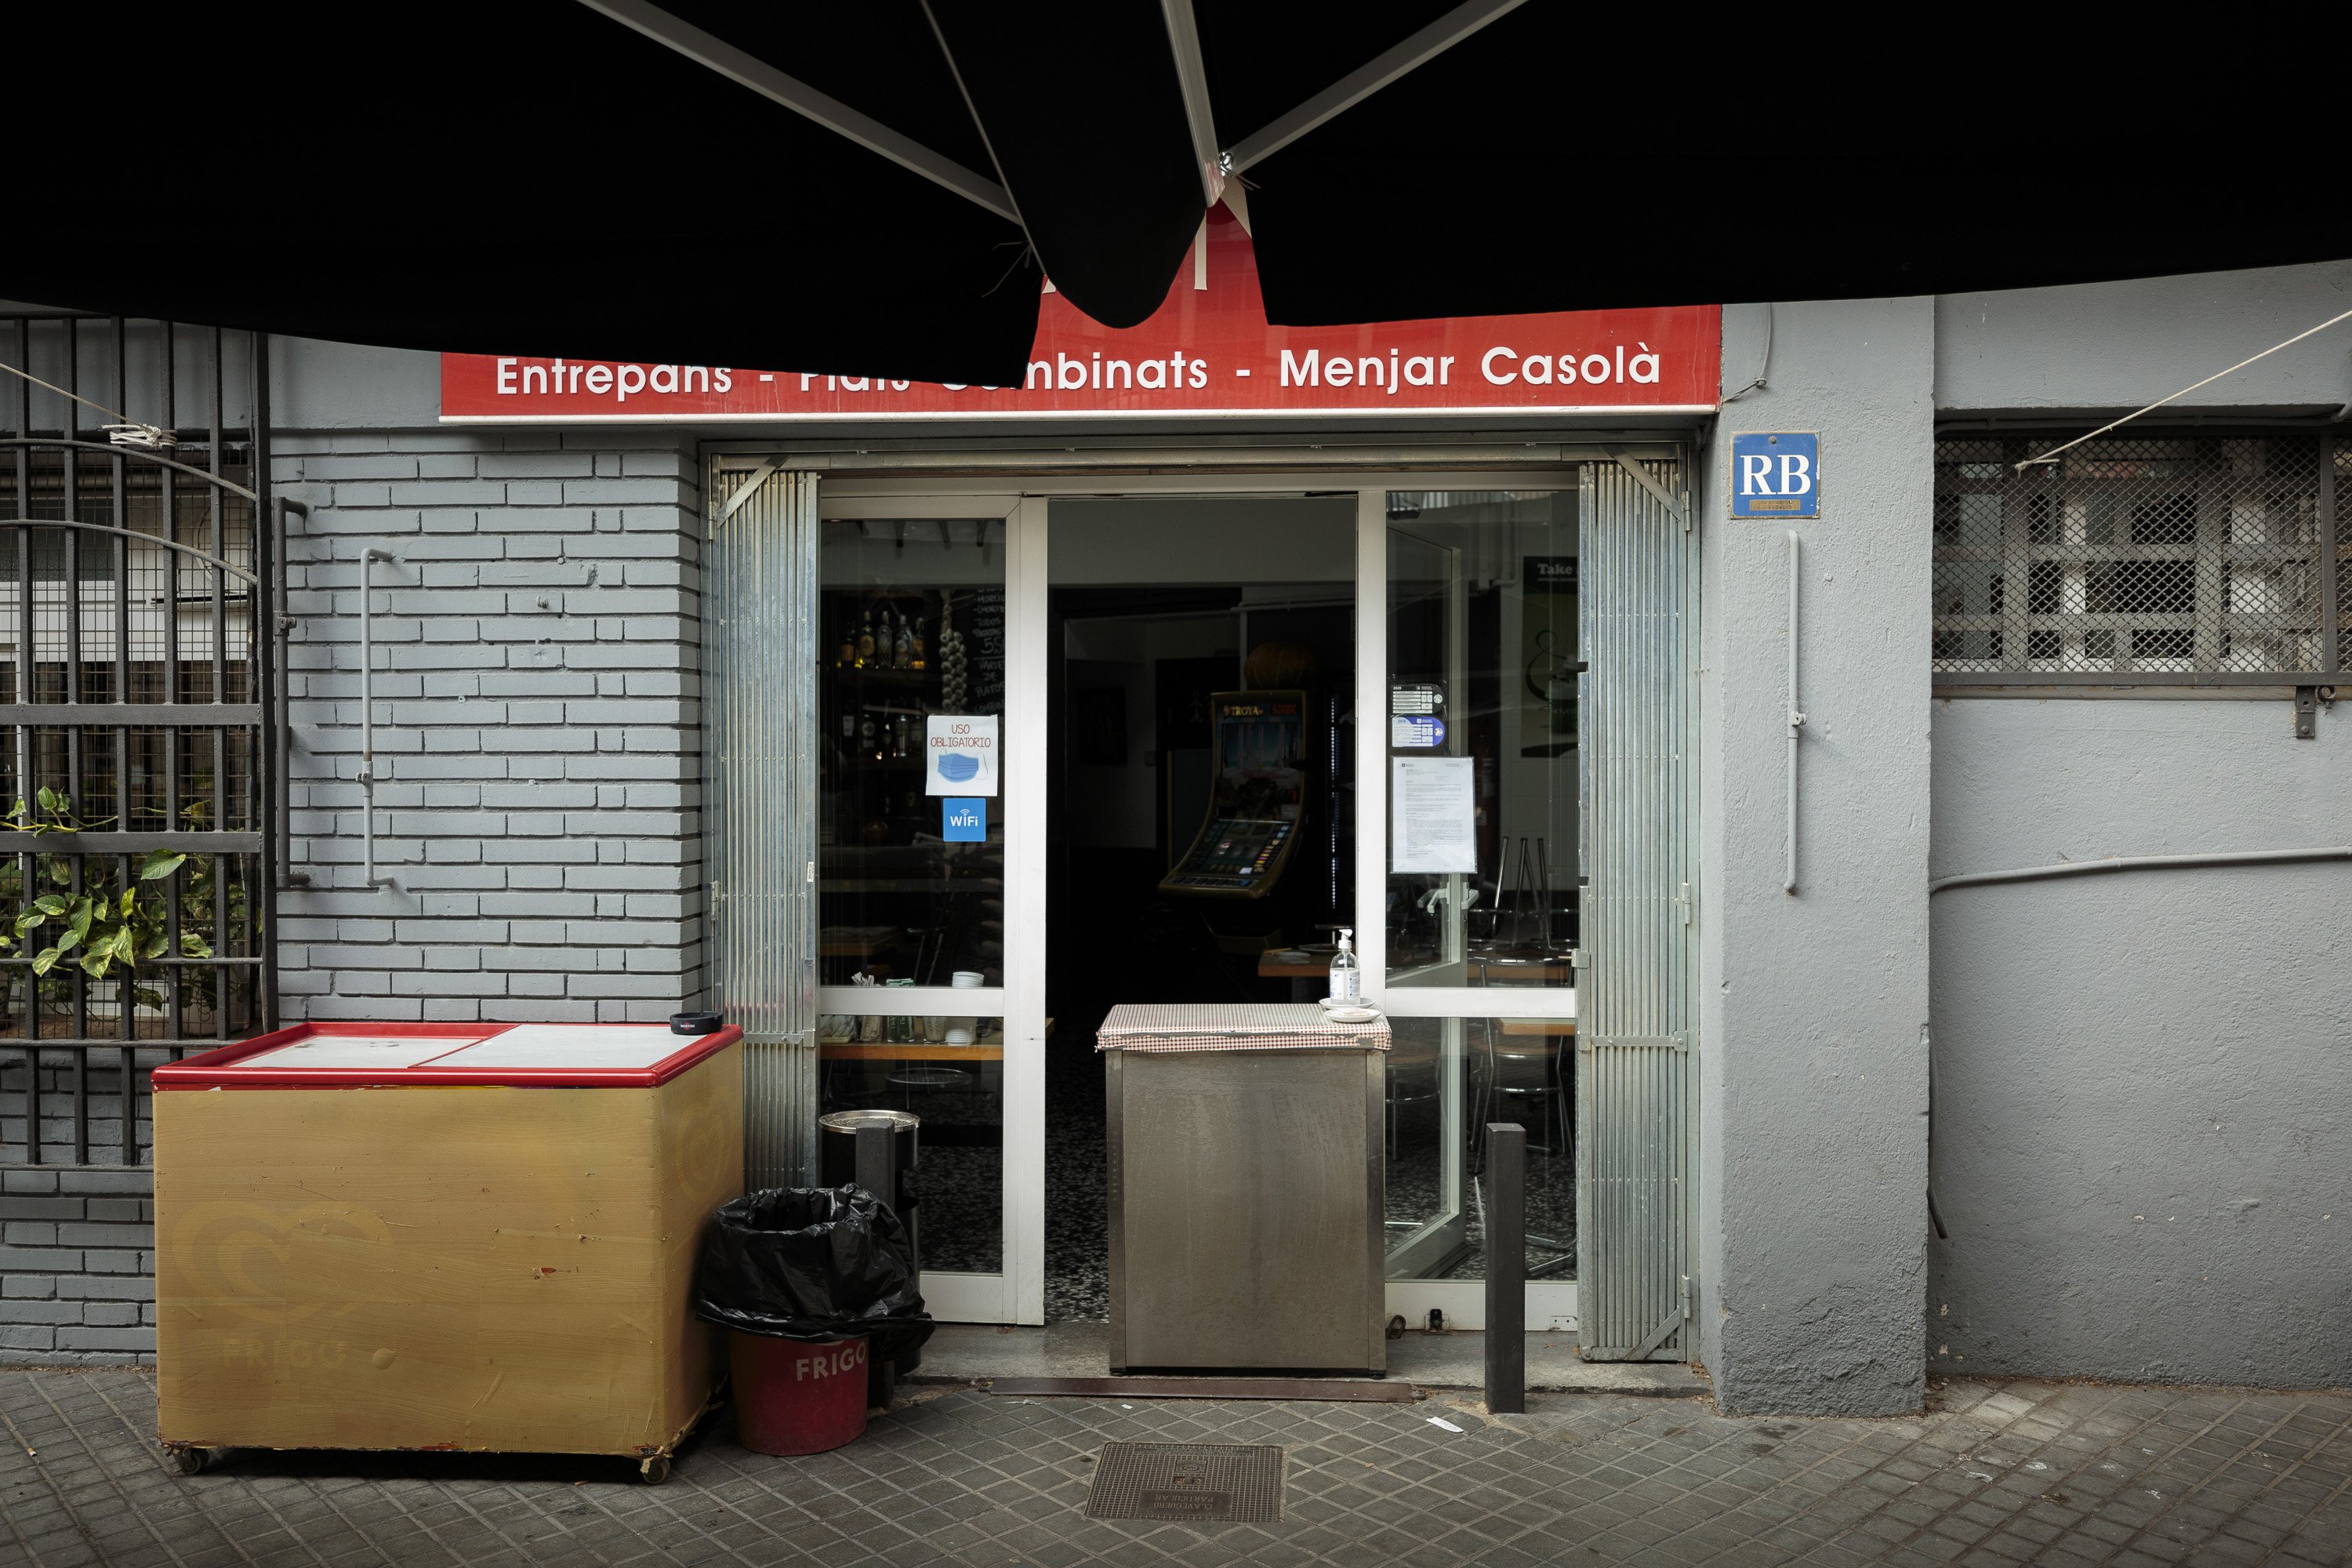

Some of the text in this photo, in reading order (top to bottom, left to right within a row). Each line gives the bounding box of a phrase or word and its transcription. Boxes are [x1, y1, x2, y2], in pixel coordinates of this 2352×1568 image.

[498, 358, 733, 402] Entrepans
[942, 351, 1208, 390] mbinats
[1281, 349, 1456, 395] Menjar
[1482, 340, 1661, 386] Casolà
[1740, 455, 1811, 495] RB
[1537, 563, 1573, 575] Take
[1230, 705, 1260, 717] TROYA
[951, 724, 971, 735] USO
[930, 737, 991, 748] OBLIGATORIO
[949, 815, 978, 827] WiFi
[797, 1341, 867, 1381] FRIGO
